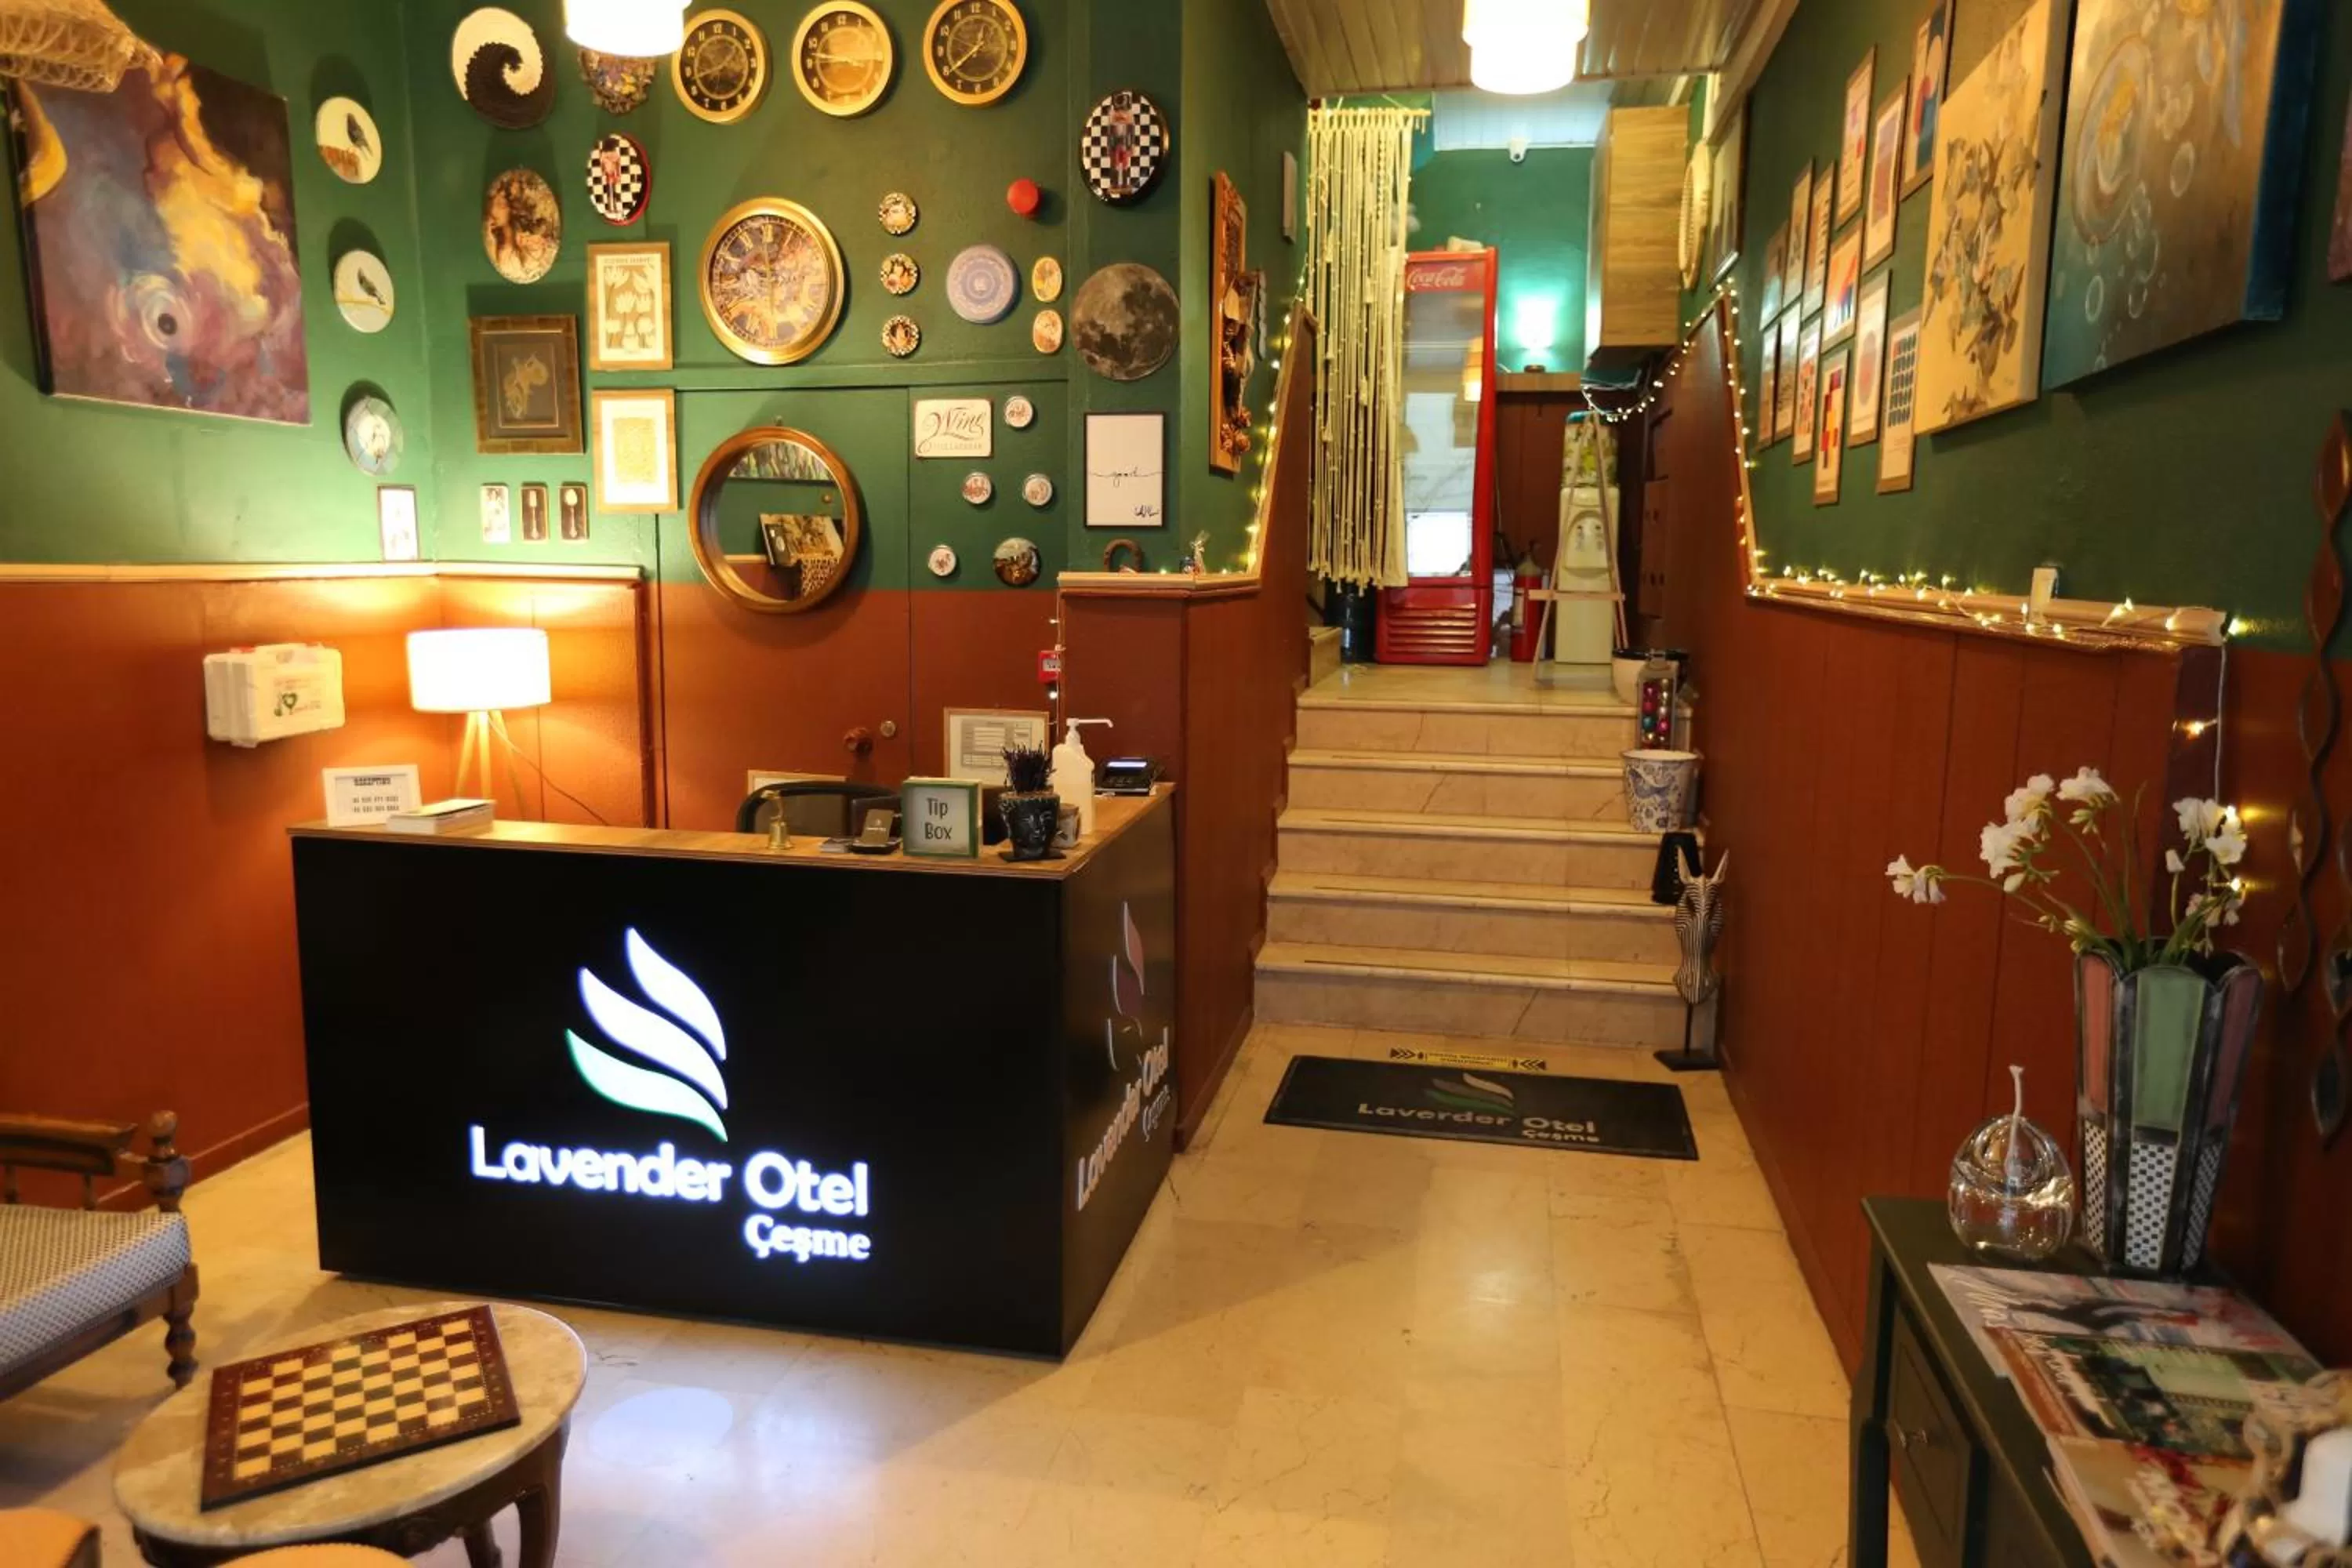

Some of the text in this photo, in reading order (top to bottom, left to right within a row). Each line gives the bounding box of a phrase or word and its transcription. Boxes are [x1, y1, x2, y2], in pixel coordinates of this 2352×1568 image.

[927, 797, 949, 820] Tip
[925, 821, 953, 840] Box
[1142, 1026, 1168, 1097] Otel
[1523, 1117, 1595, 1134] Otel
[470, 1125, 869, 1217] Lavender Otel
[743, 1214, 872, 1263] Çeşme
